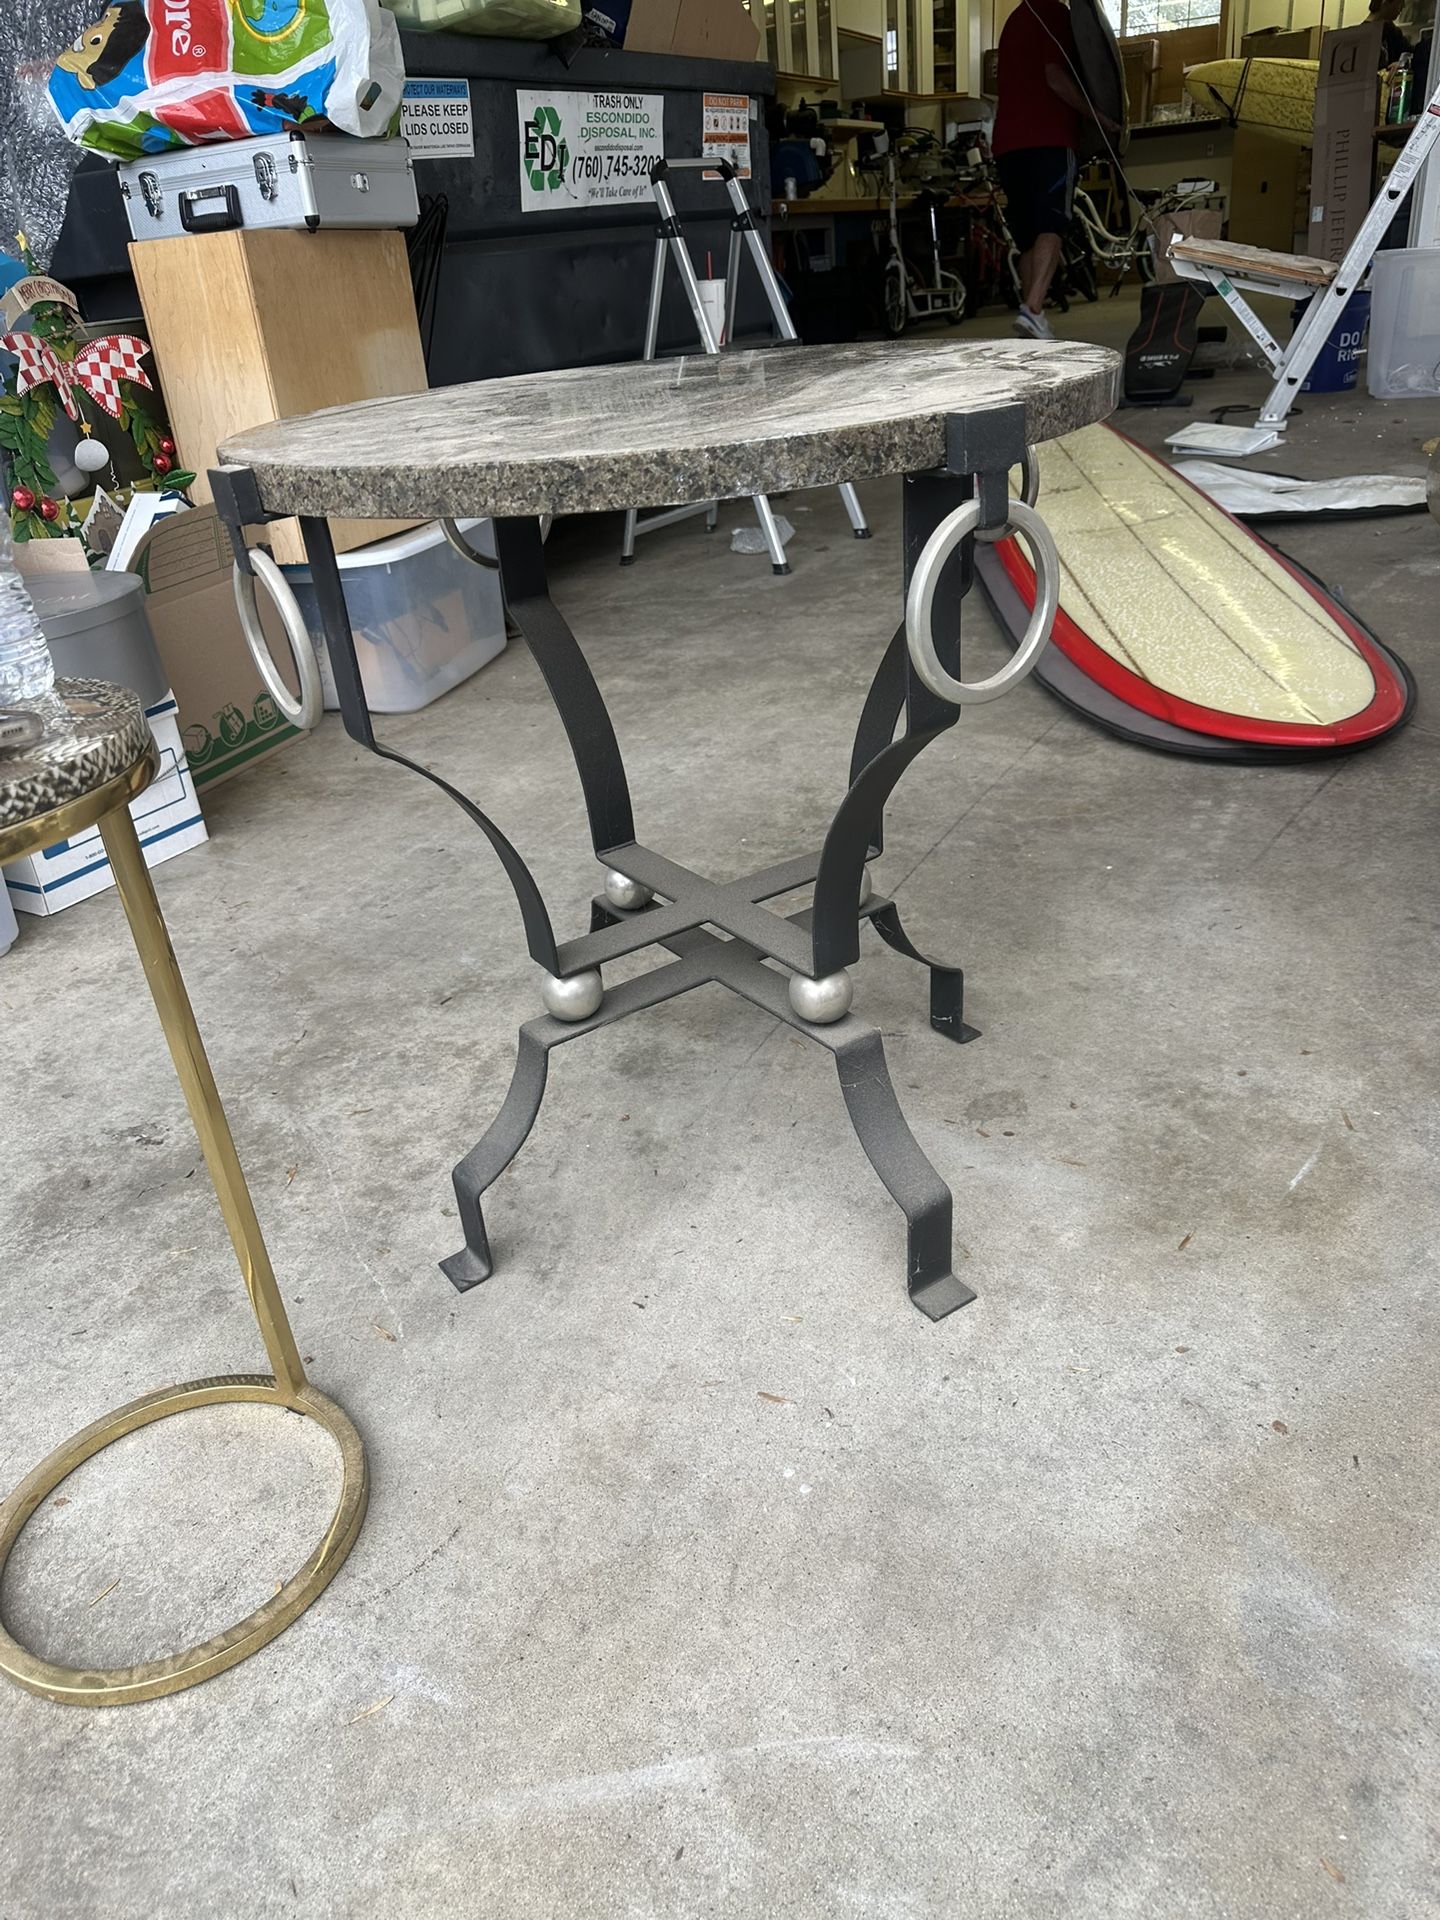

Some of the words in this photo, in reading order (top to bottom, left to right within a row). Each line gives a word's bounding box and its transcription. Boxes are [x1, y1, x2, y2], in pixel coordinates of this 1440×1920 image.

[594, 94, 622, 109] TRASH
[624, 96, 644, 109] ONLY
[402, 104, 441, 117] PLEASE
[443, 104, 469, 117] KEEP
[586, 111, 650, 124] ESCONDIDO
[405, 123, 428, 136] LIDS
[430, 122, 469, 136] CLOSED
[580, 126, 637, 140] DISPOSAL,
[639, 127, 657, 139] INC.
[572, 155, 603, 184] (760)
[1333, 129, 1350, 202] PHILLIP
[606, 186, 618, 198] Take
[619, 185, 632, 197] Care
[632, 185, 639, 199] of
[1340, 331, 1360, 348] DO
